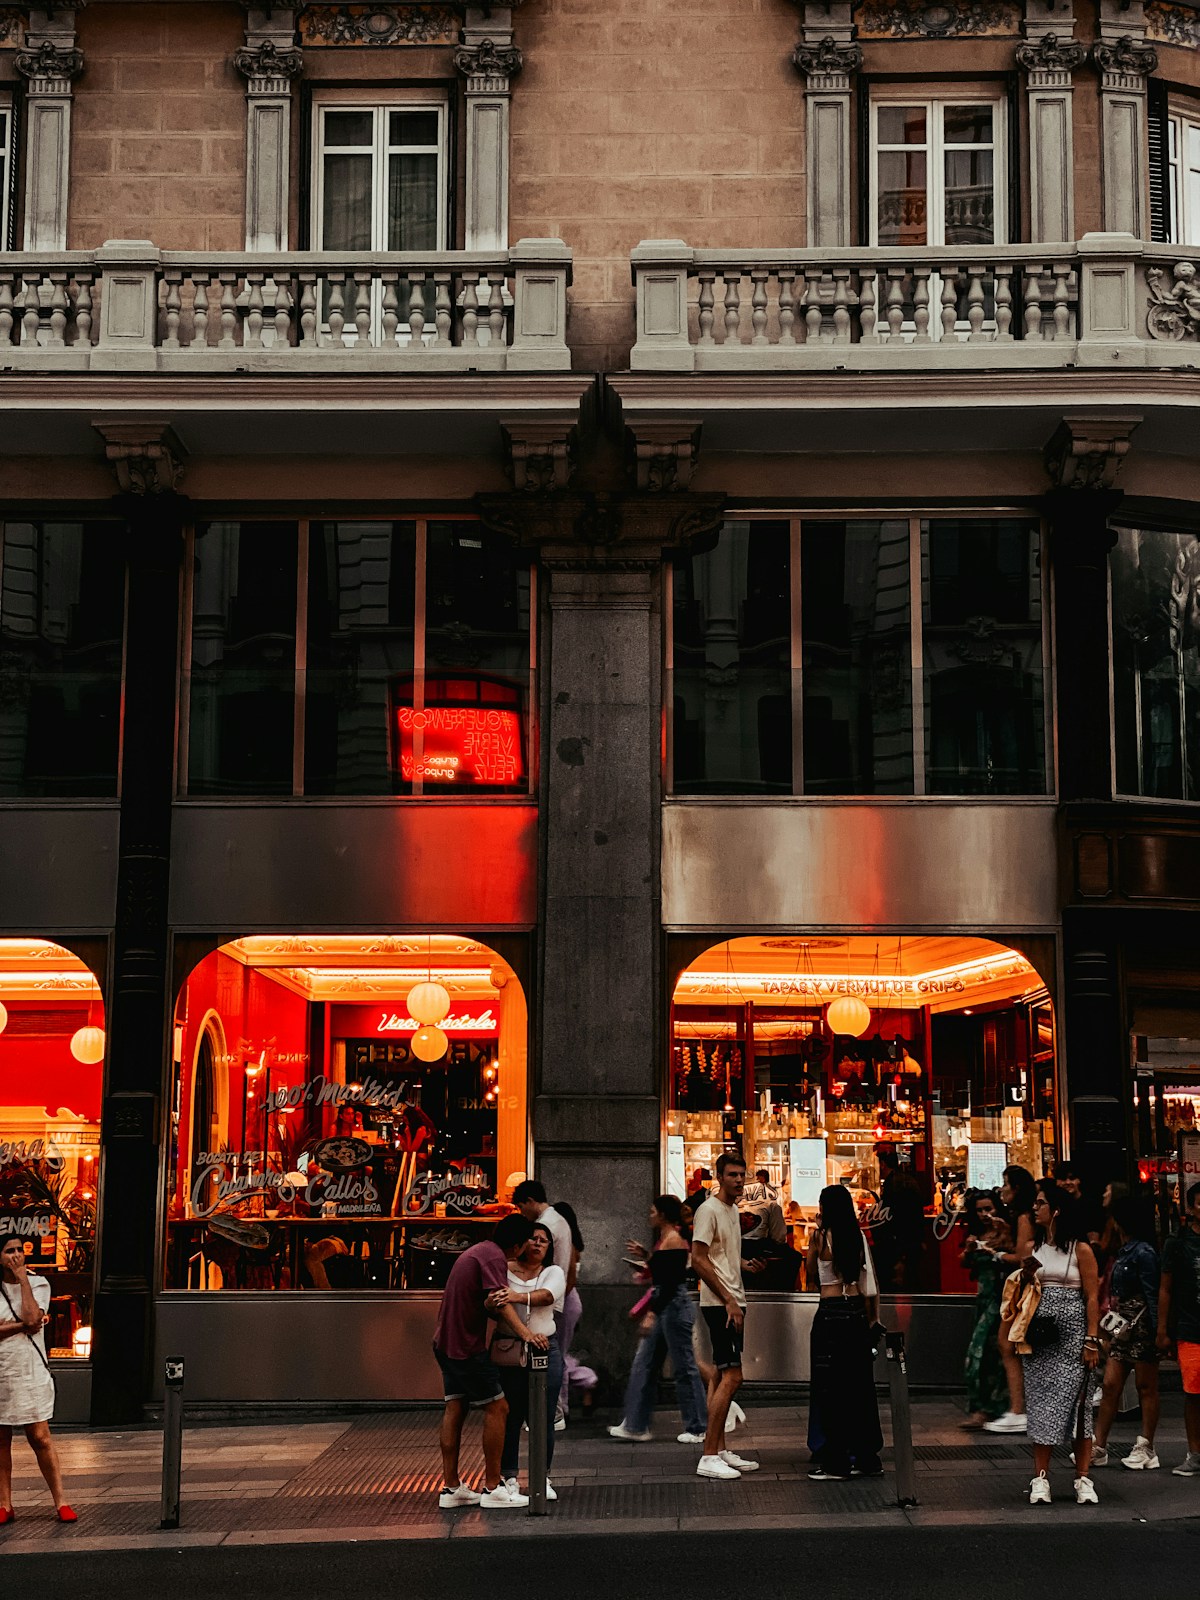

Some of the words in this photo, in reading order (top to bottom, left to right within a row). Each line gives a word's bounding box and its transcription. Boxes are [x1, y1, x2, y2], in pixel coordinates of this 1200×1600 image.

[761, 981, 807, 994] TAPAS
[812, 981, 822, 993] Y
[825, 980, 890, 993] VERMUT
[893, 980, 913, 993] DE
[917, 979, 965, 993] GRIFO
[313, 1075, 406, 1110] Madrid
[192, 1164, 296, 1218] Calamares
[304, 1172, 379, 1207] Callos
[443, 1191, 485, 1215] Rusa
[338, 1202, 382, 1214] MADRILEÑA
